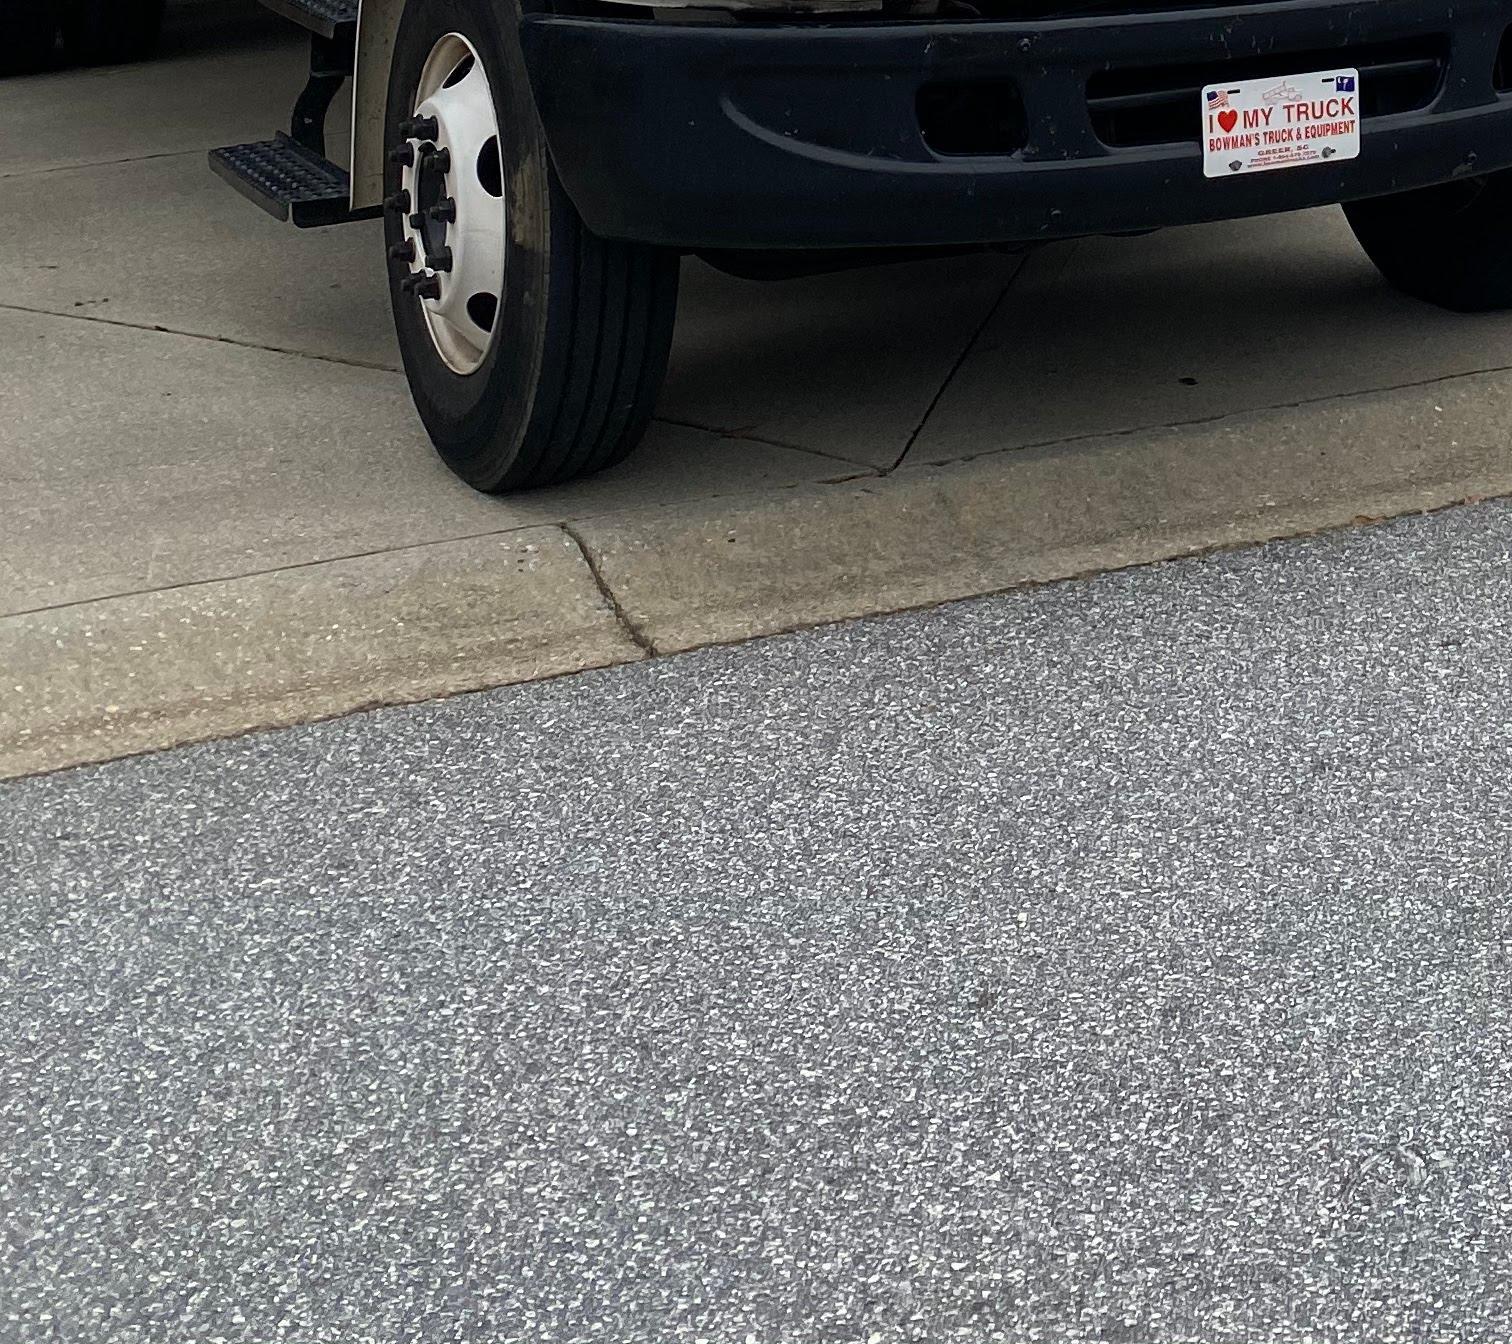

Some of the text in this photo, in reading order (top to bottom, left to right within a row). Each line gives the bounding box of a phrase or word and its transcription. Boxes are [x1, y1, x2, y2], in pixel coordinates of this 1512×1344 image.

[1209, 96, 1355, 133] I MY TRUCK
[1209, 120, 1355, 152] BOWMAN'S TRUCK & EQUIPMENT
